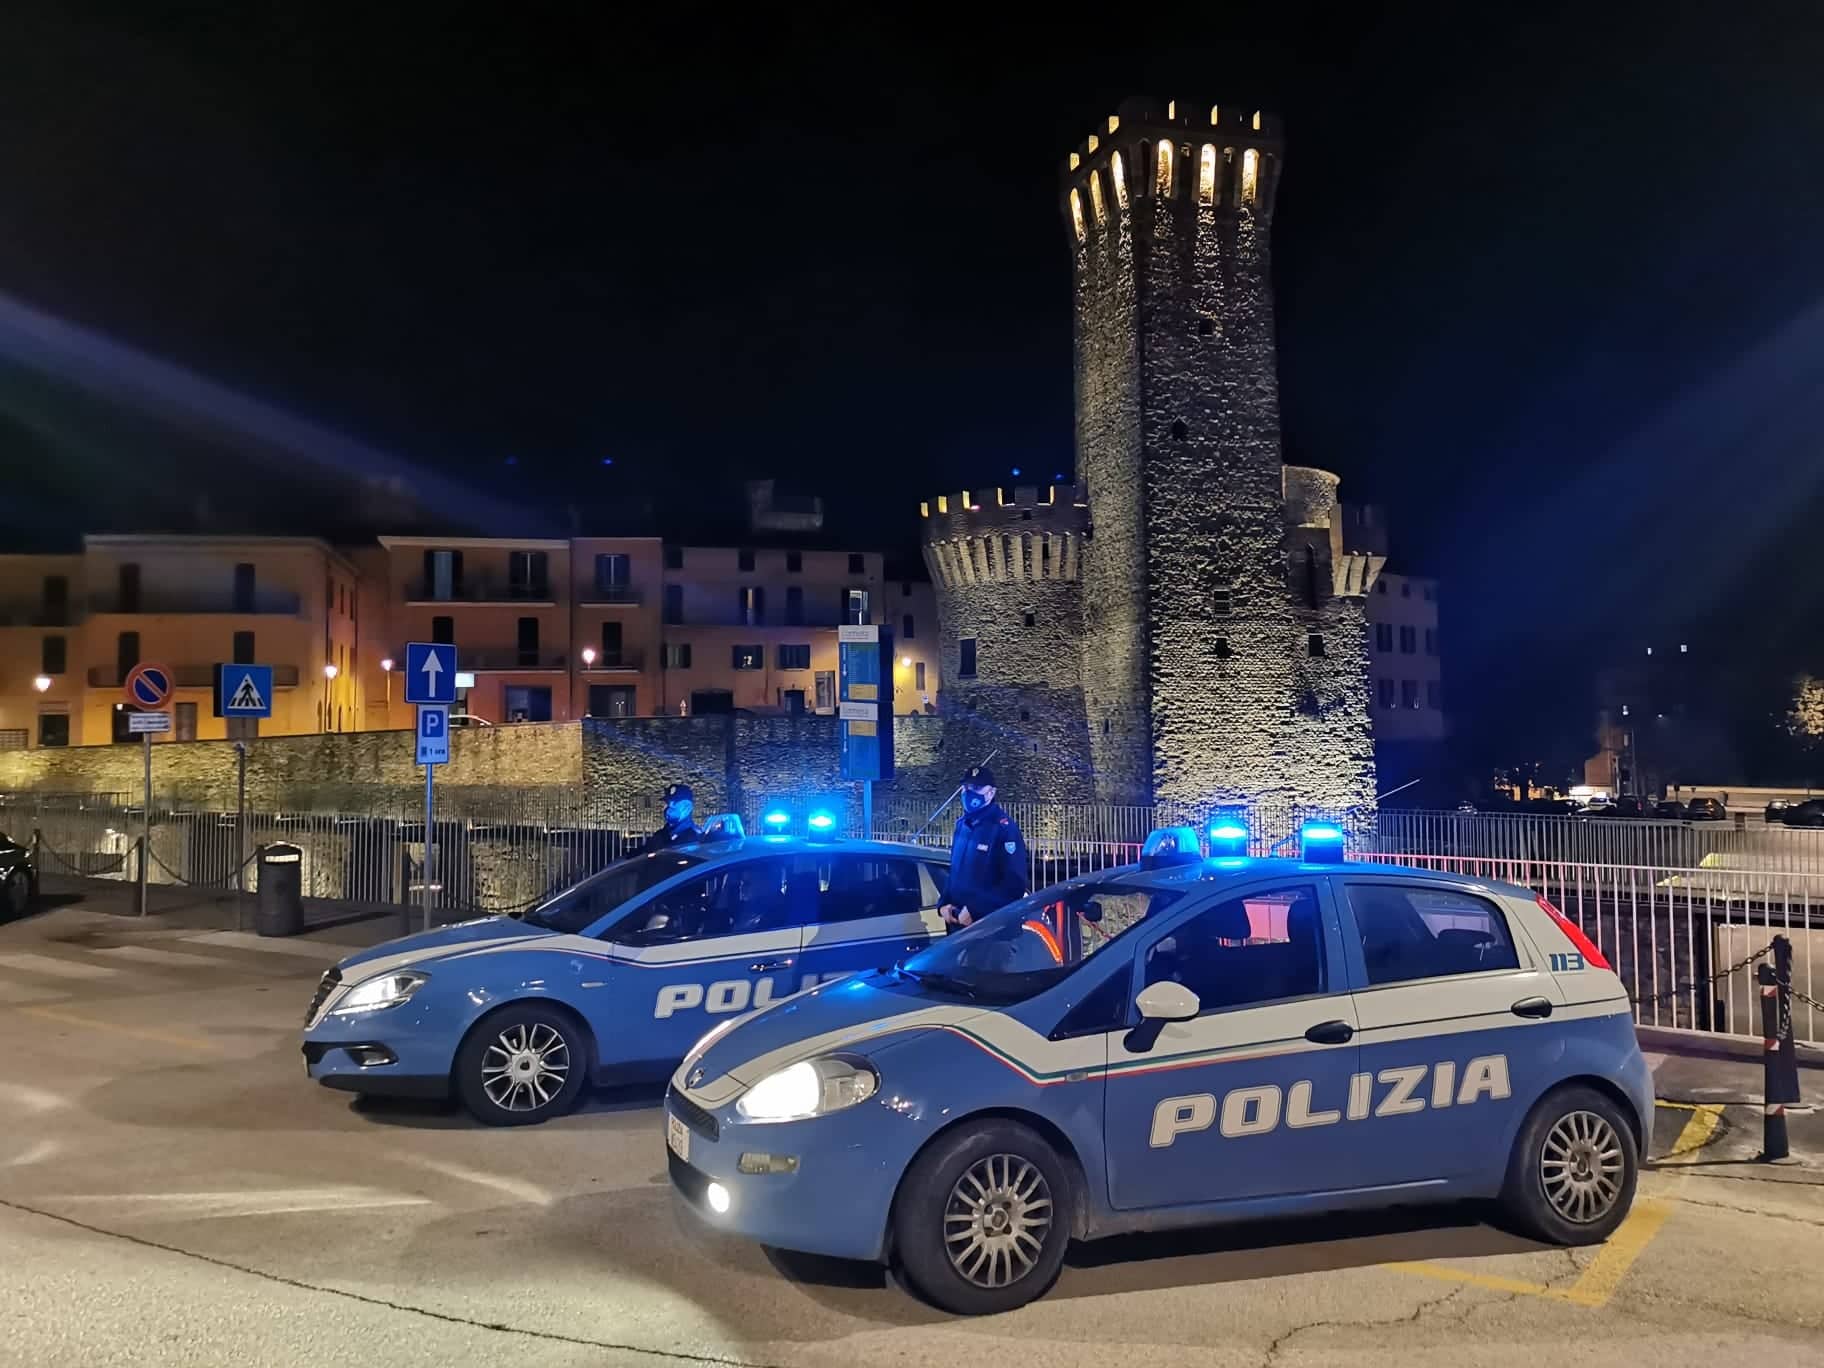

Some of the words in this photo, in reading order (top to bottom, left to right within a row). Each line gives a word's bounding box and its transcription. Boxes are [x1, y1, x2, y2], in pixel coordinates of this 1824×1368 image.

[426, 713, 439, 735] P
[1549, 952, 1585, 971] 113
[1149, 1053, 1512, 1148] POLIZIA
